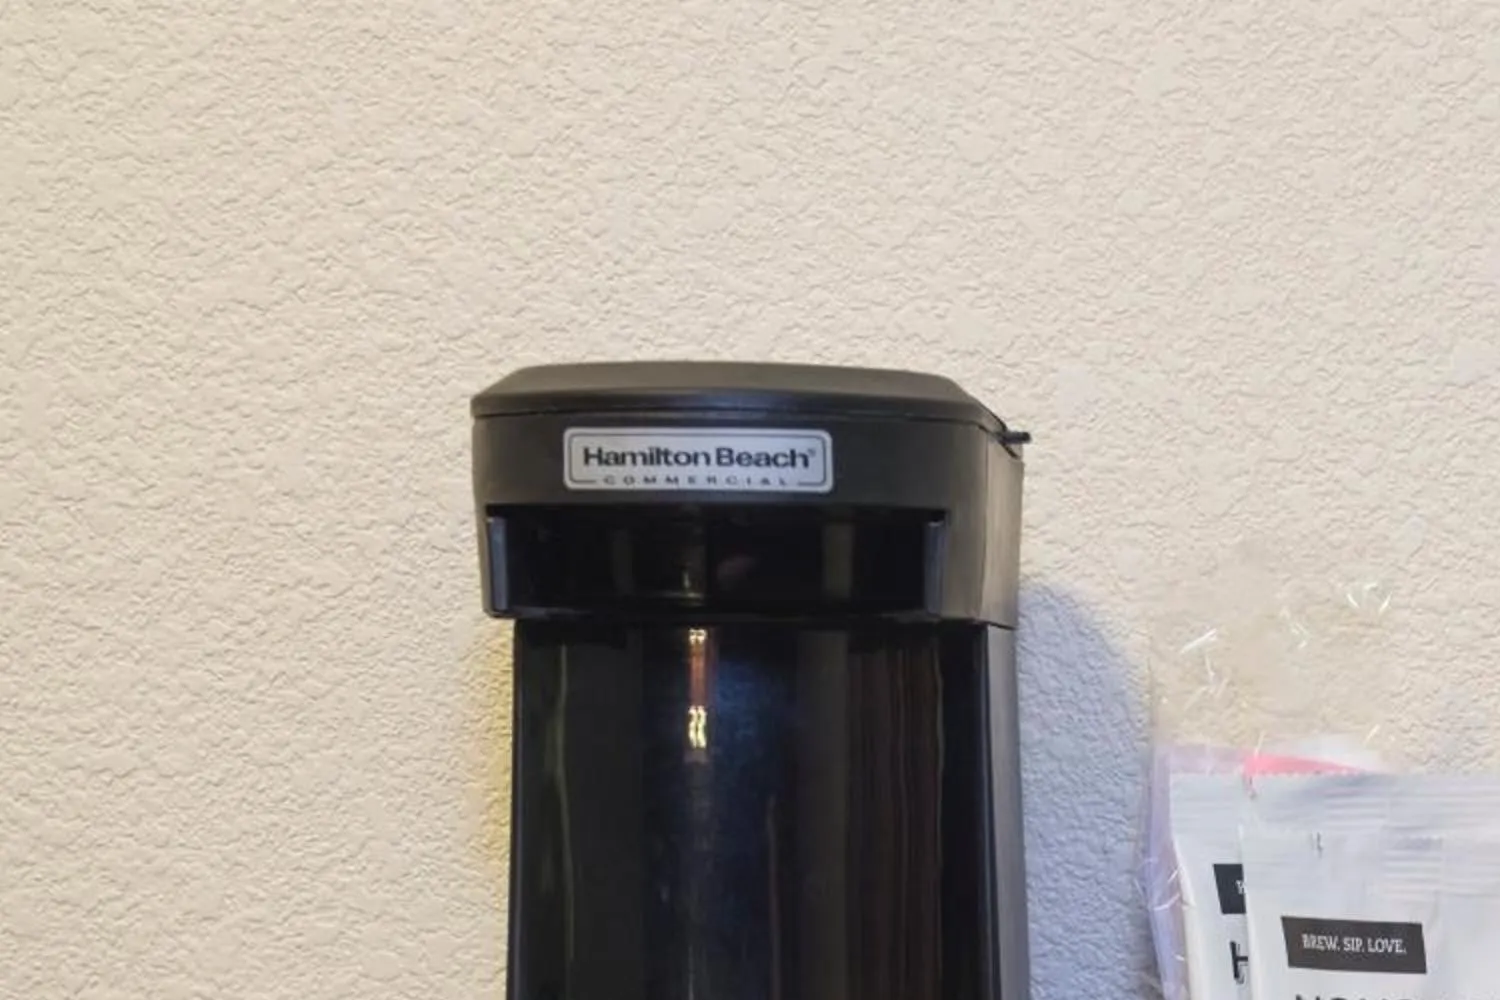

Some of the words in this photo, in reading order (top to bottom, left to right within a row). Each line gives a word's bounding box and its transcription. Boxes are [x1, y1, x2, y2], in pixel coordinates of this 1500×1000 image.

[583, 447, 711, 467] Hamilton
[603, 475, 787, 487] COMMERCIAL
[1301, 933, 1341, 951] BREW.
[1343, 937, 1365, 951] SIP.
[1367, 938, 1407, 954] LOVE.
